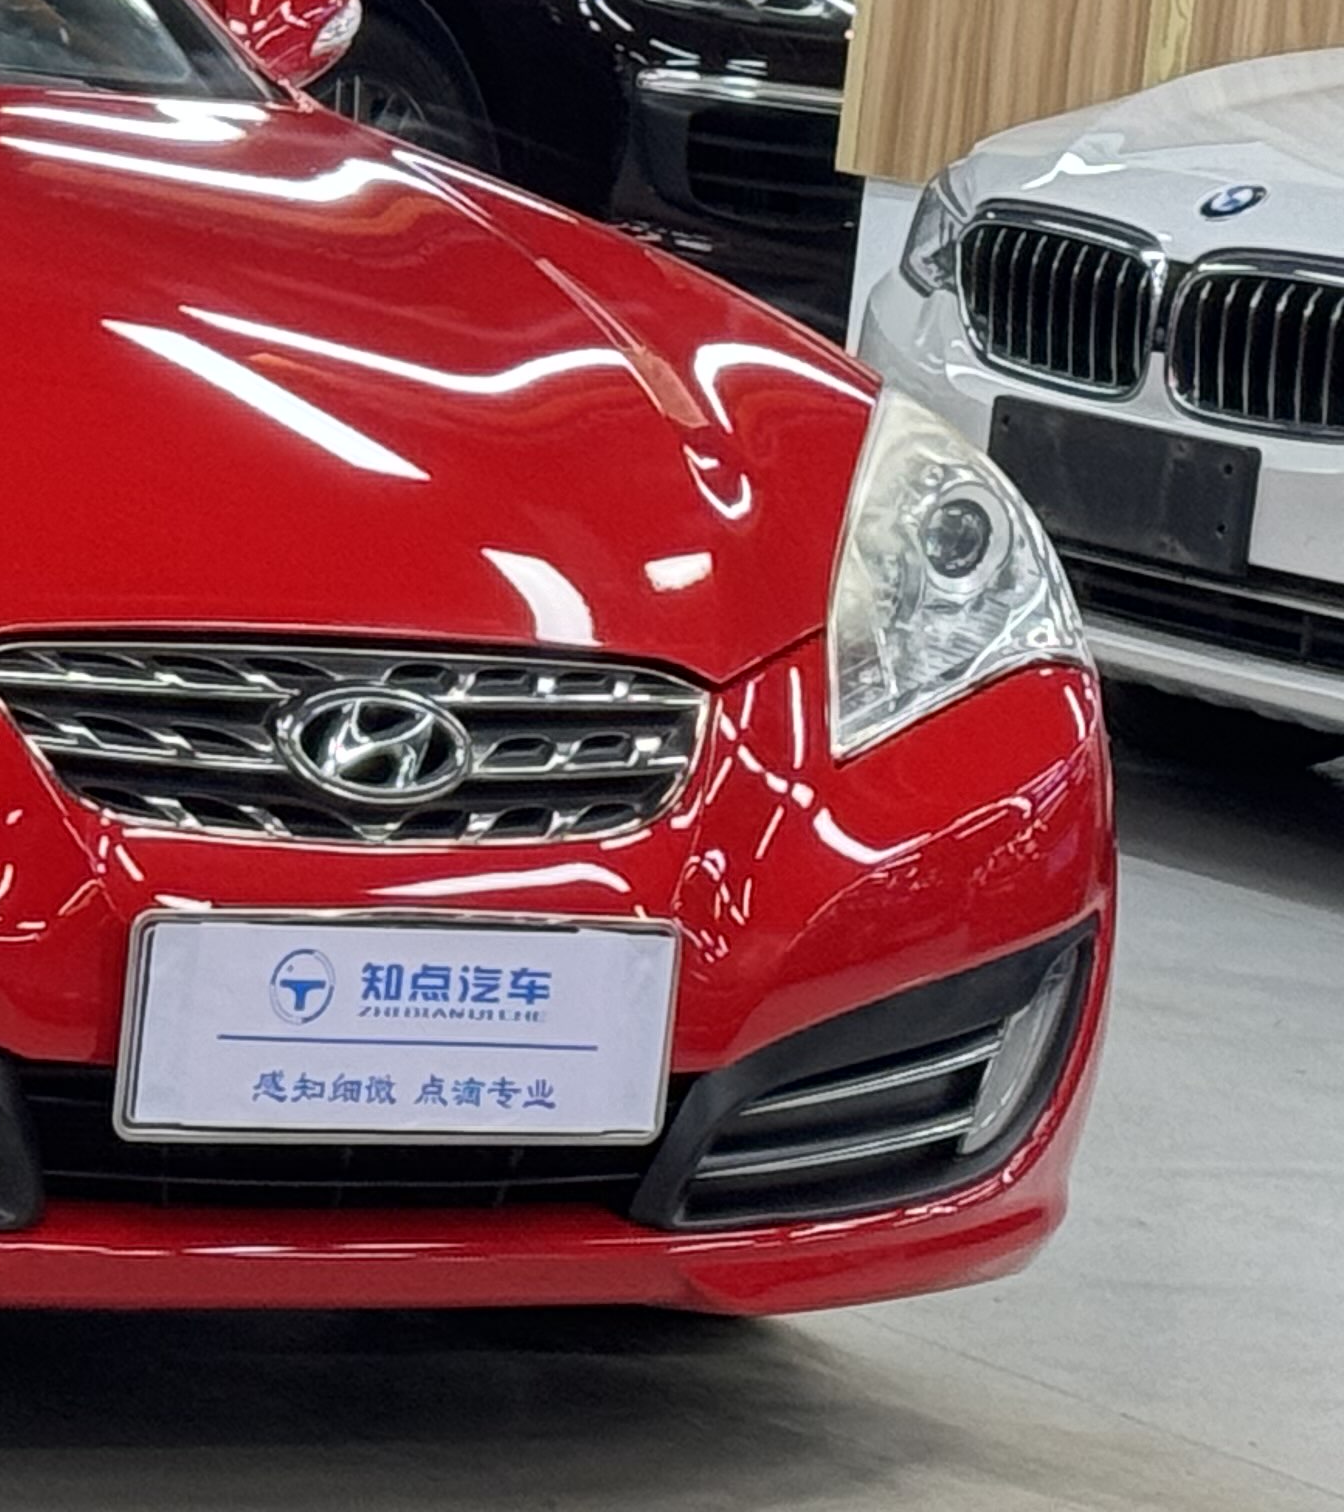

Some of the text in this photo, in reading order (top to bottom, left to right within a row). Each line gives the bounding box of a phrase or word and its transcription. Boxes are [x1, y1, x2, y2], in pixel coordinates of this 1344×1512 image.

[360, 962, 552, 1006] 知点汽车
[251, 1068, 398, 1107] 感知细微
